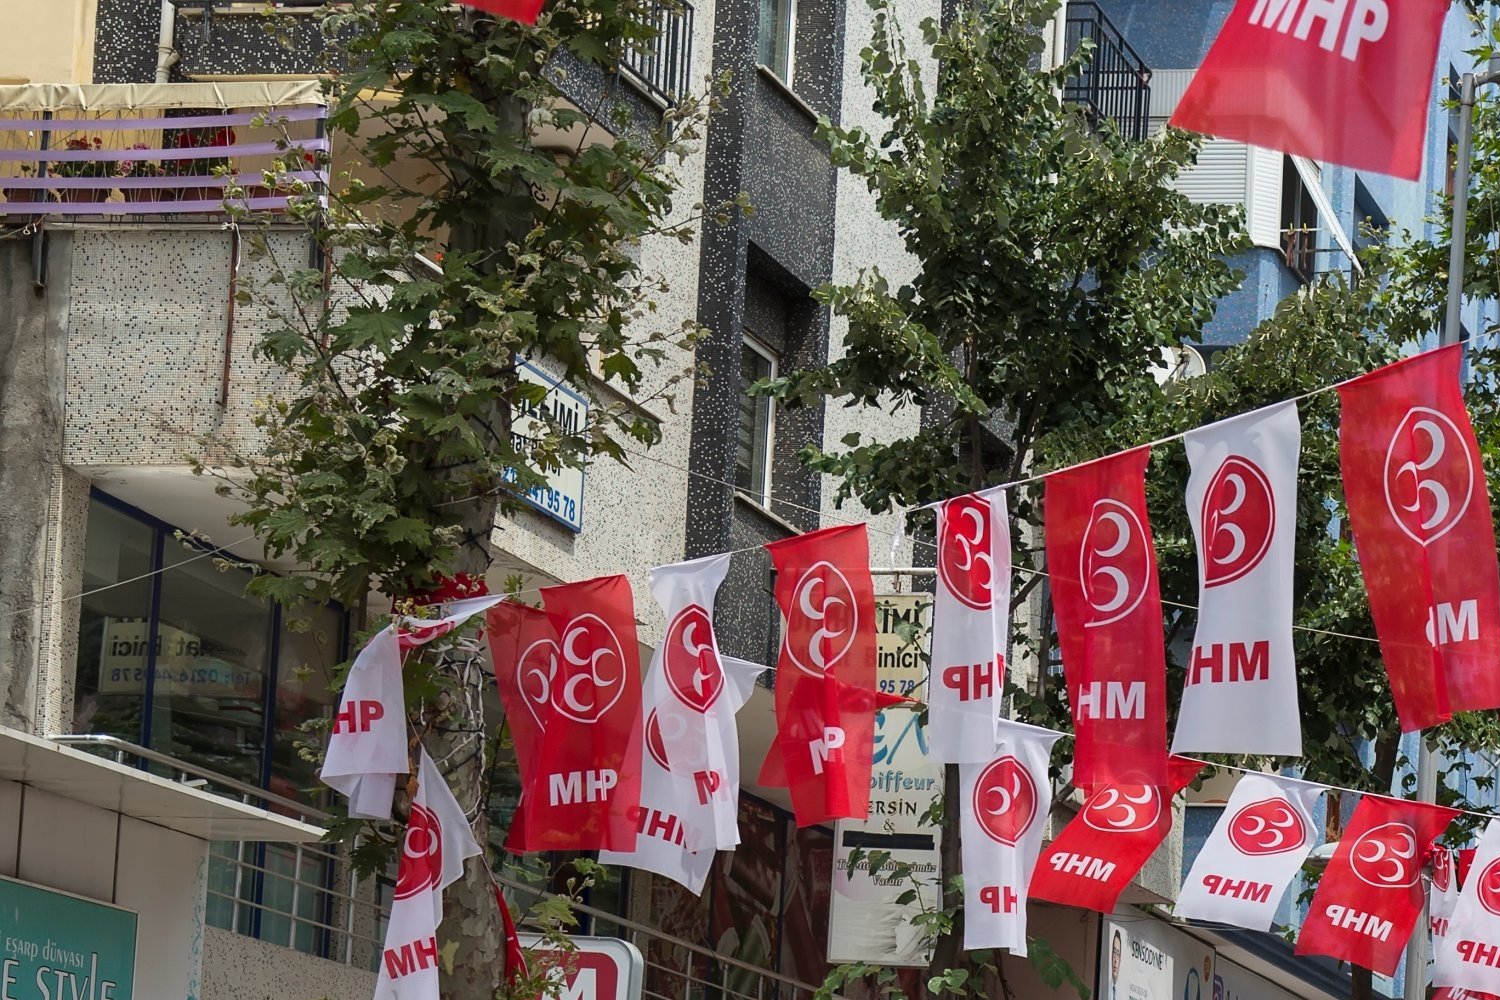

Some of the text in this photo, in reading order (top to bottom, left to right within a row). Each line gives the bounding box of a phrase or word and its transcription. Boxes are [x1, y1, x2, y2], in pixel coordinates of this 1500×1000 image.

[1248, 0, 1388, 62] MHP
[563, 495, 576, 522] 78
[879, 680, 915, 694] 95 78
[332, 700, 384, 735] HP
[868, 769, 935, 791] oiffeur
[384, 936, 439, 980] MH
